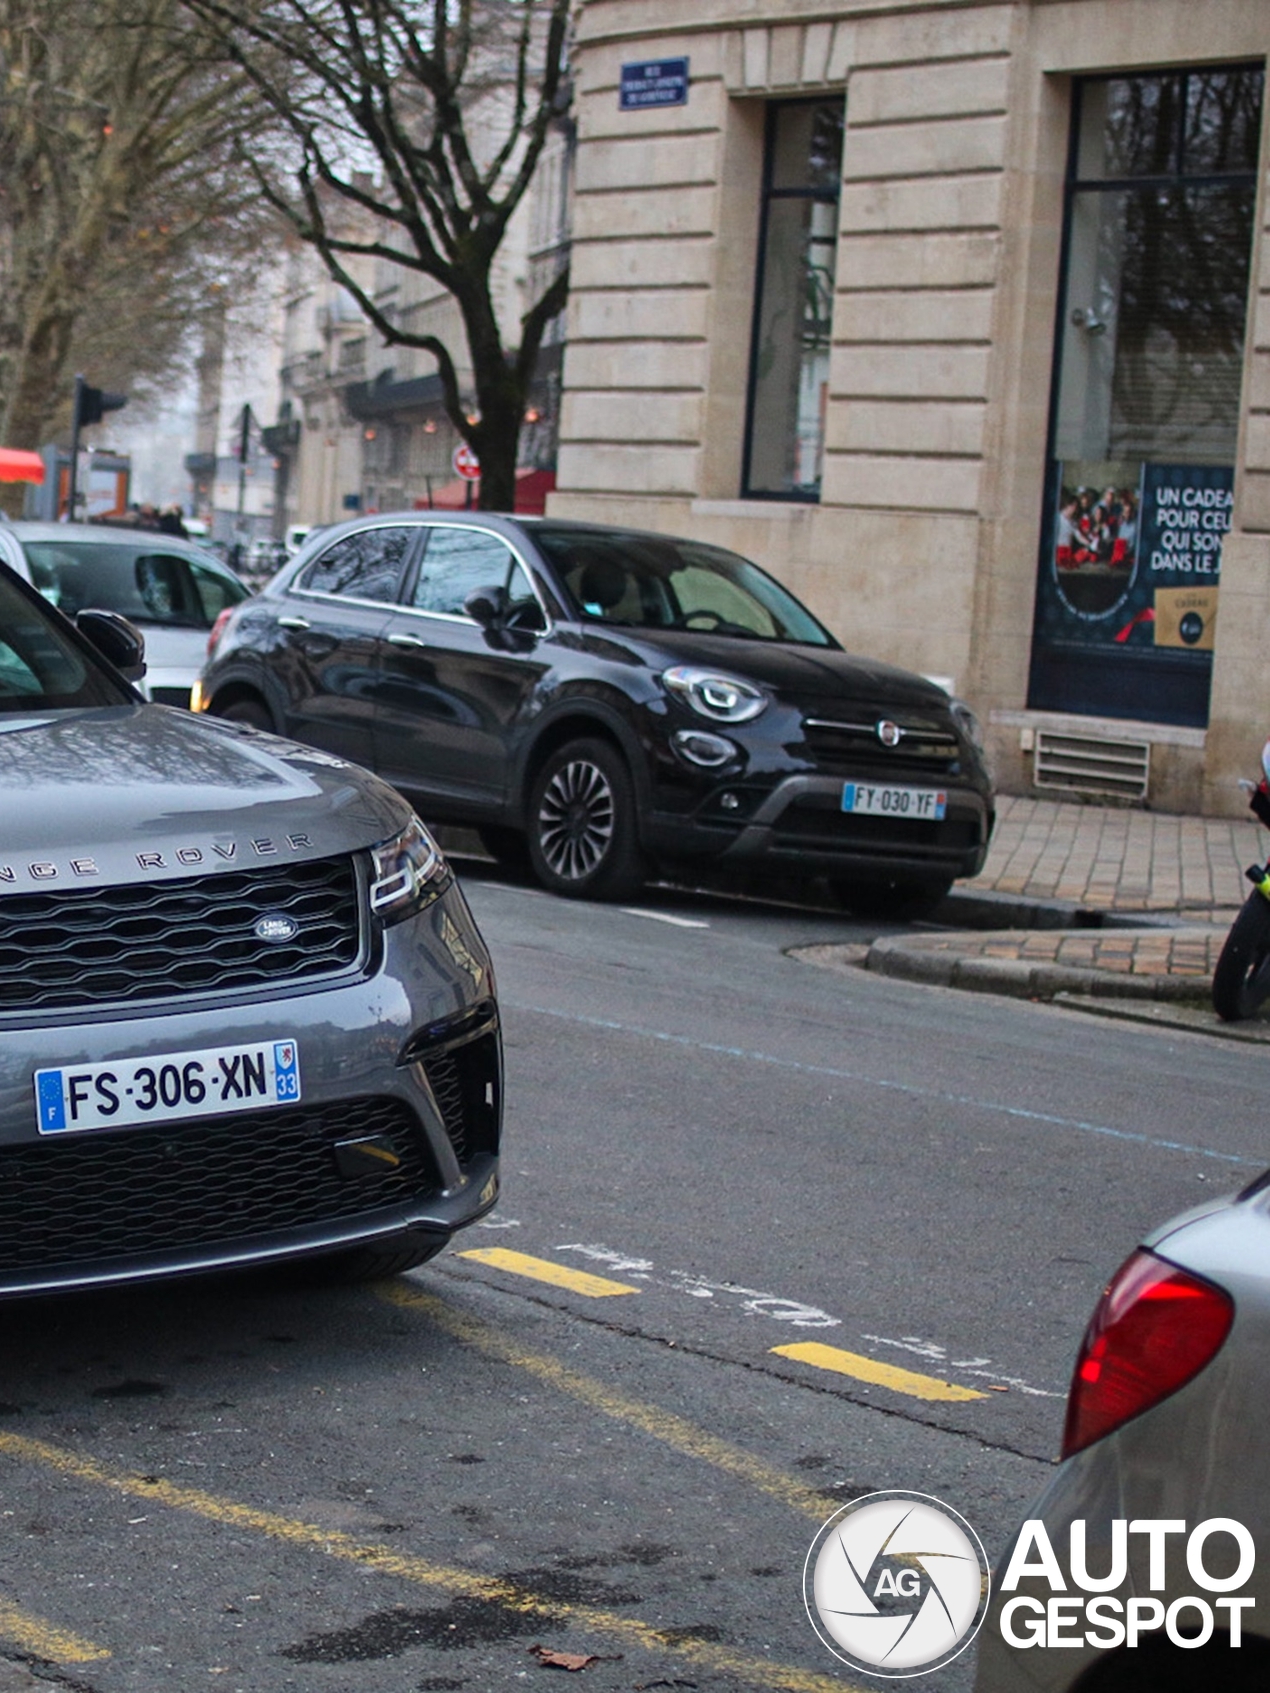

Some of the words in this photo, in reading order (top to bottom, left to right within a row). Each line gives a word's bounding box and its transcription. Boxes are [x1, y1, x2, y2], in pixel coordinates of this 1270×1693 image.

[1156, 487, 1180, 505] UN
[1157, 508, 1199, 528] POUR
[1161, 531, 1190, 551] QUI
[1151, 551, 1193, 572] DANS
[1195, 554, 1212, 574] LE
[135, 833, 314, 870] ROVER
[68, 1052, 267, 1120] FS-306-XN
[277, 1073, 297, 1096] 33
[47, 1107, 57, 1121] F
